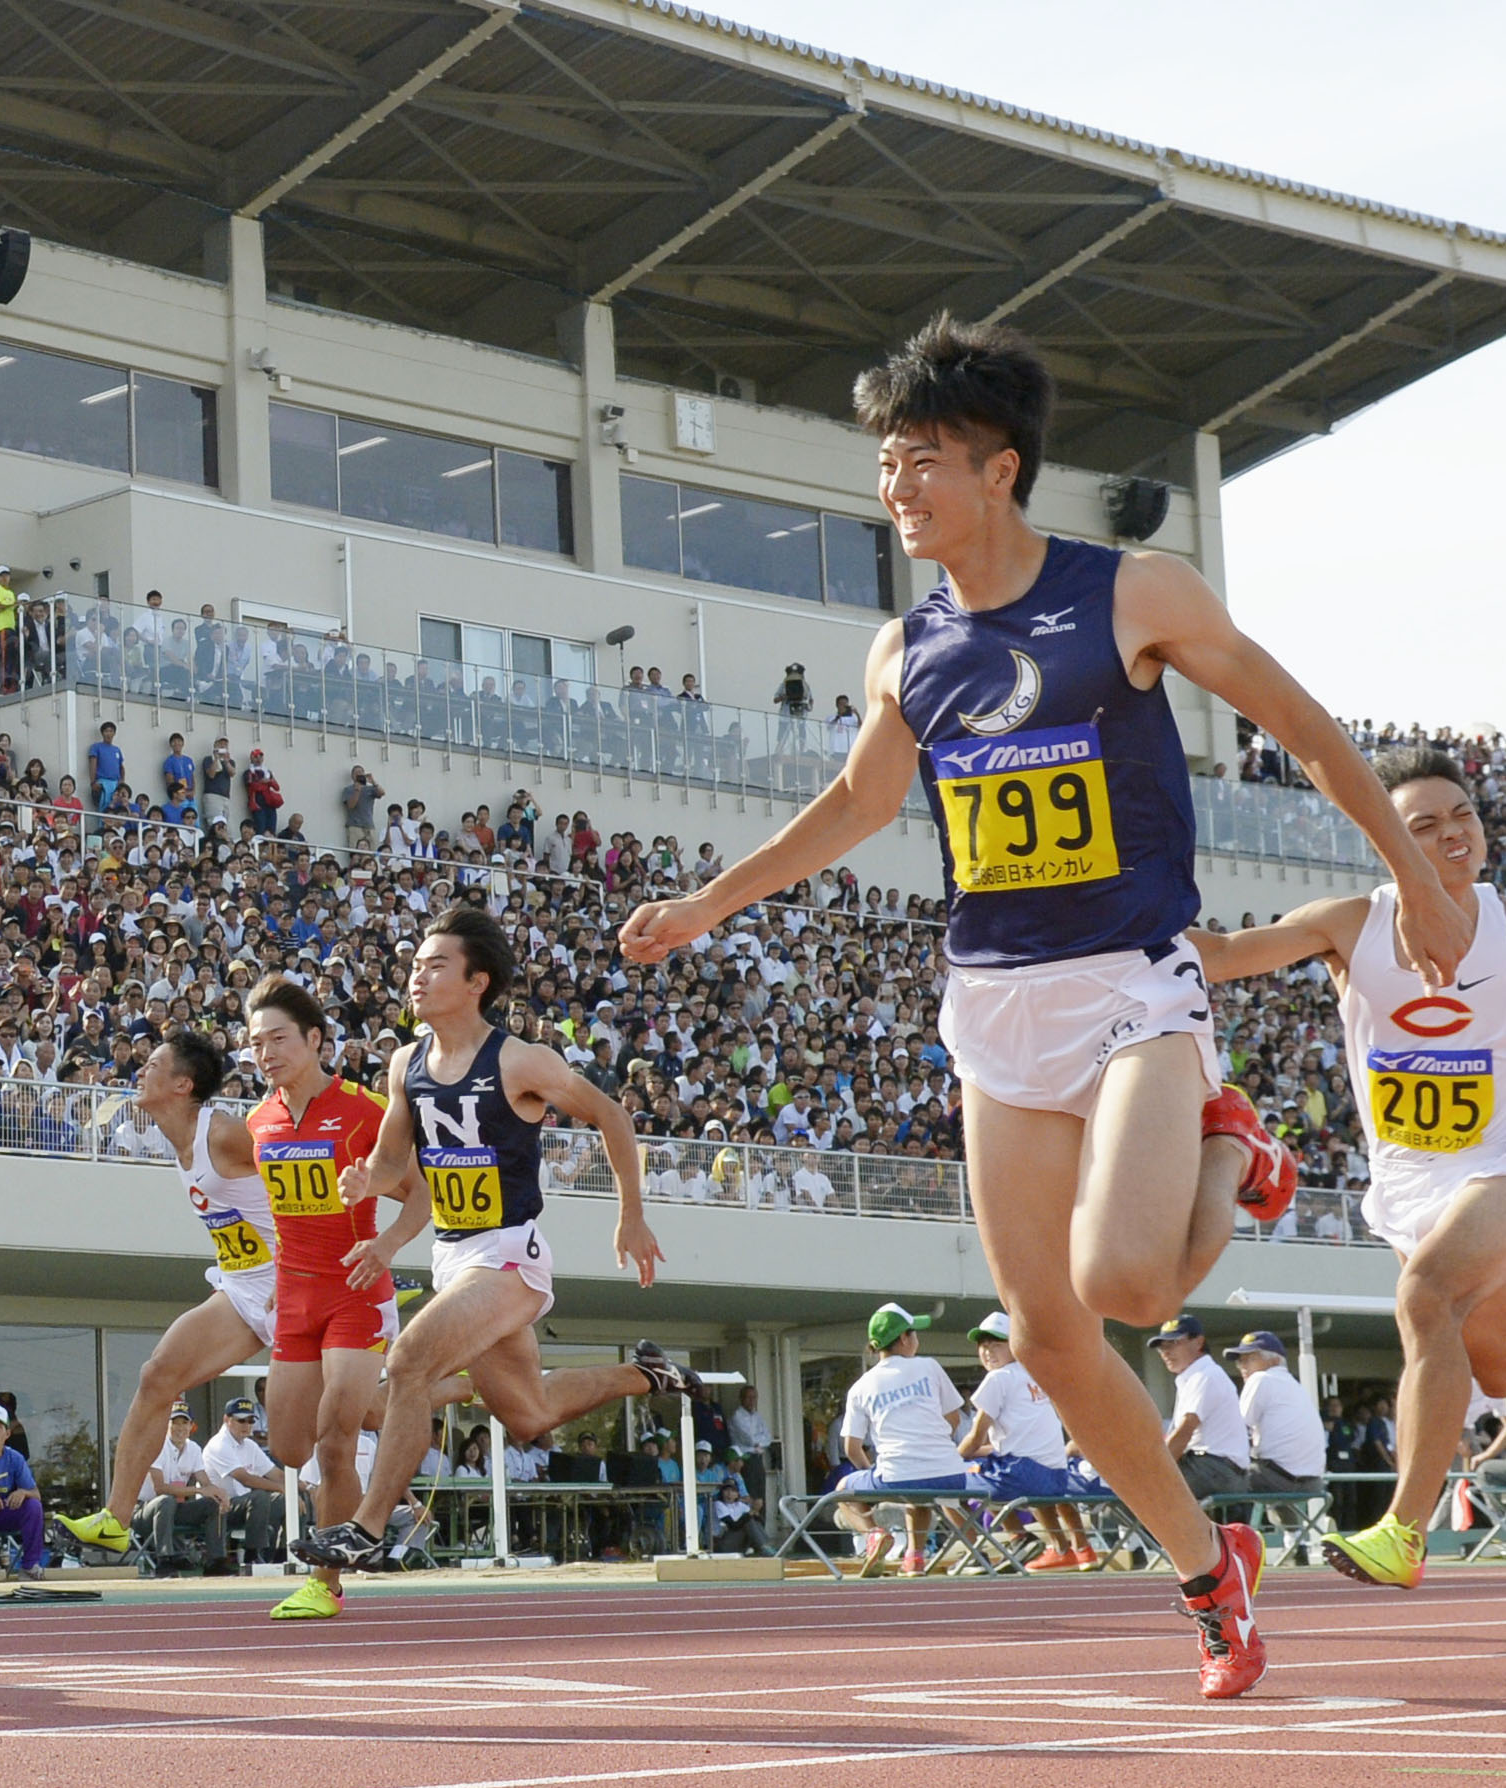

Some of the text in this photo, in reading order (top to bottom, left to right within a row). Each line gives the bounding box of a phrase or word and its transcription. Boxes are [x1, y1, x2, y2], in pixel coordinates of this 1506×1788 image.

[953, 772, 1093, 863] 799
[1378, 1077, 1480, 1132] 205
[268, 1163, 329, 1201] 510
[433, 1171, 492, 1213] 406
[526, 1228, 540, 1259] 6
